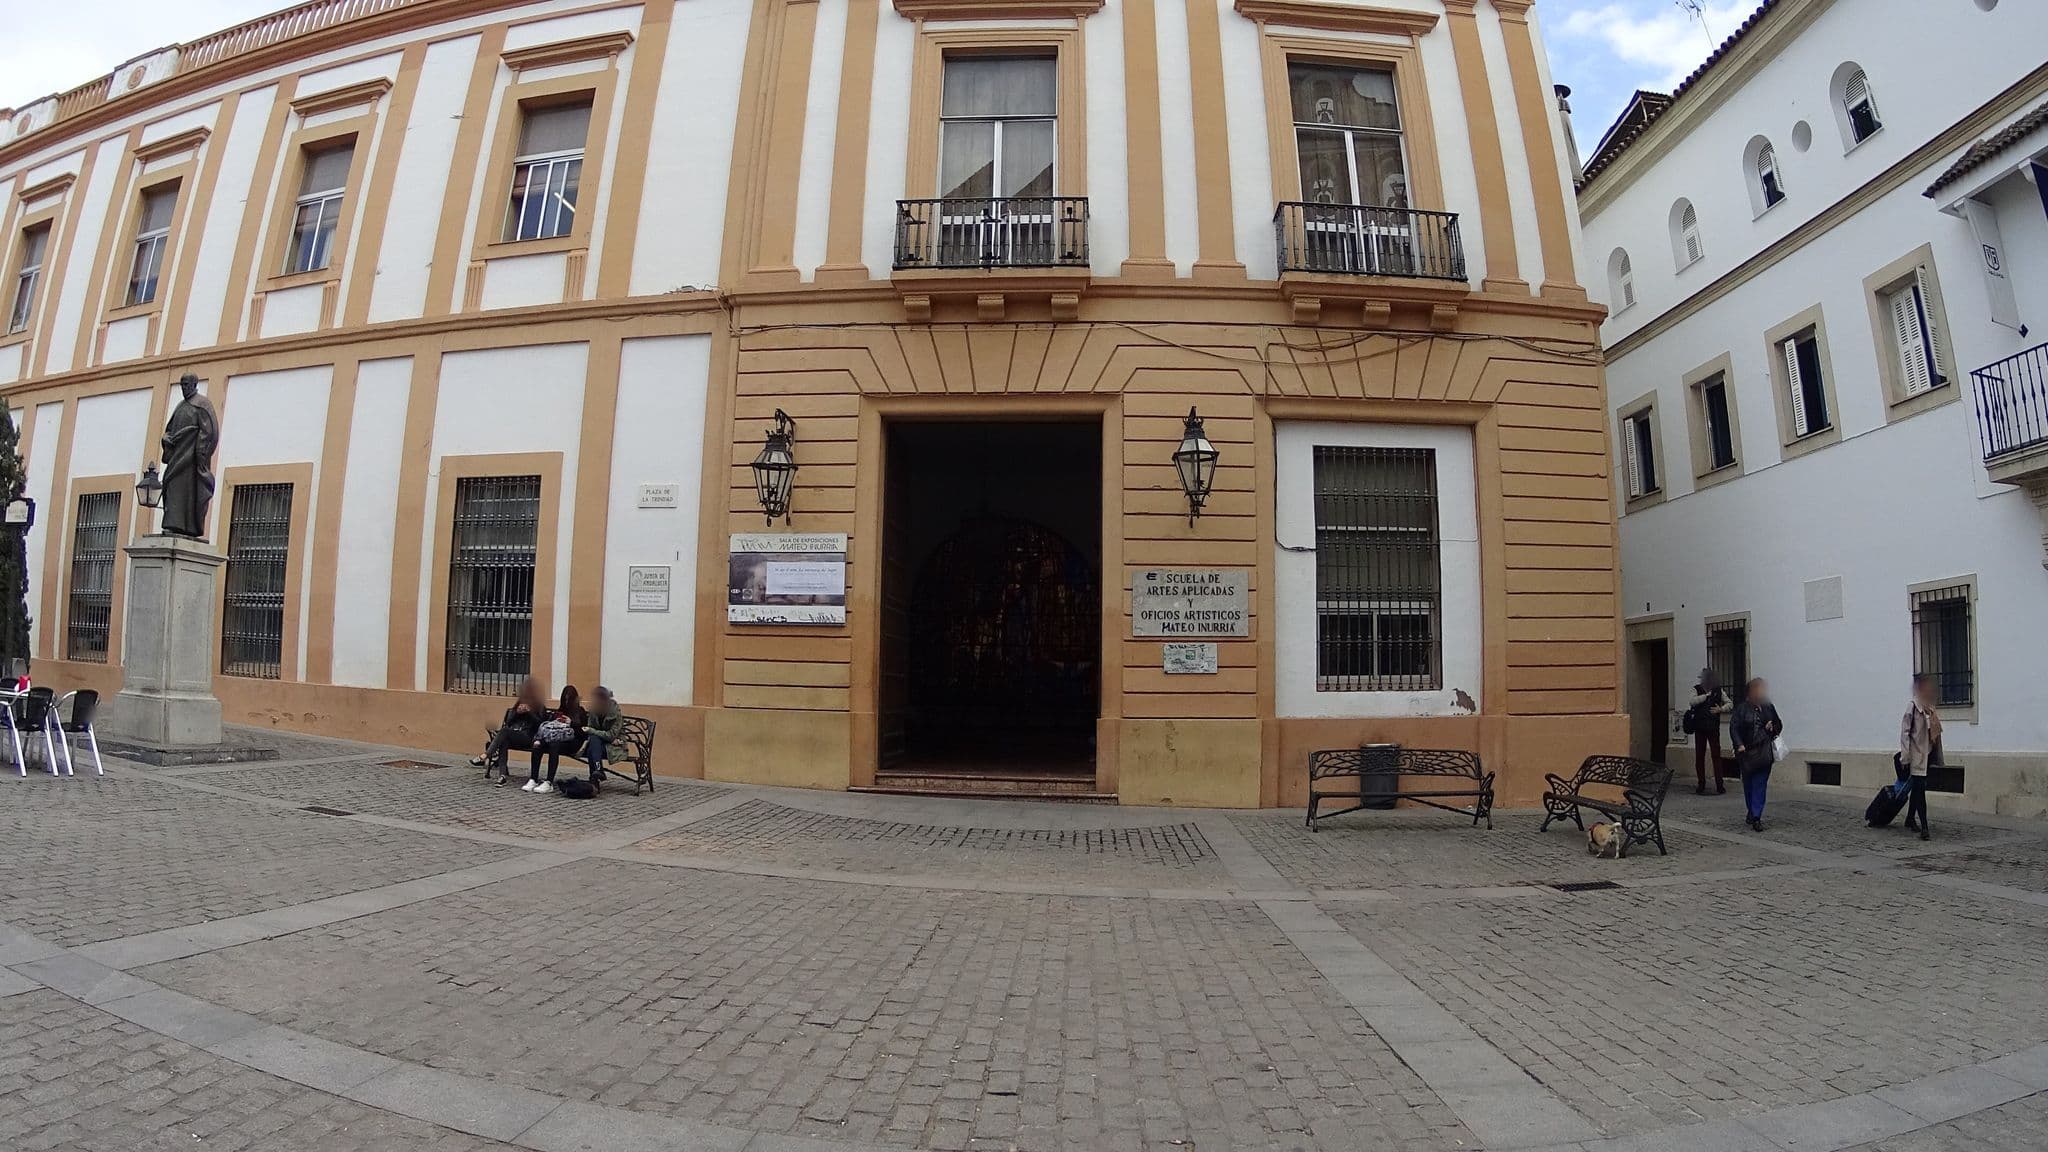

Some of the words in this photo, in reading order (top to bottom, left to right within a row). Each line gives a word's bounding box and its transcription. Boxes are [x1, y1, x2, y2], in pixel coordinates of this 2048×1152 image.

[779, 543, 808, 551] MATEO
[1208, 573, 1221, 584] DE
[1146, 586, 1179, 596] ARTES
[1181, 586, 1235, 596] APLICADAS
[1187, 598, 1194, 608] Y
[1141, 610, 1180, 620] OFICIOS
[1184, 610, 1241, 620] ARTISTICOS
